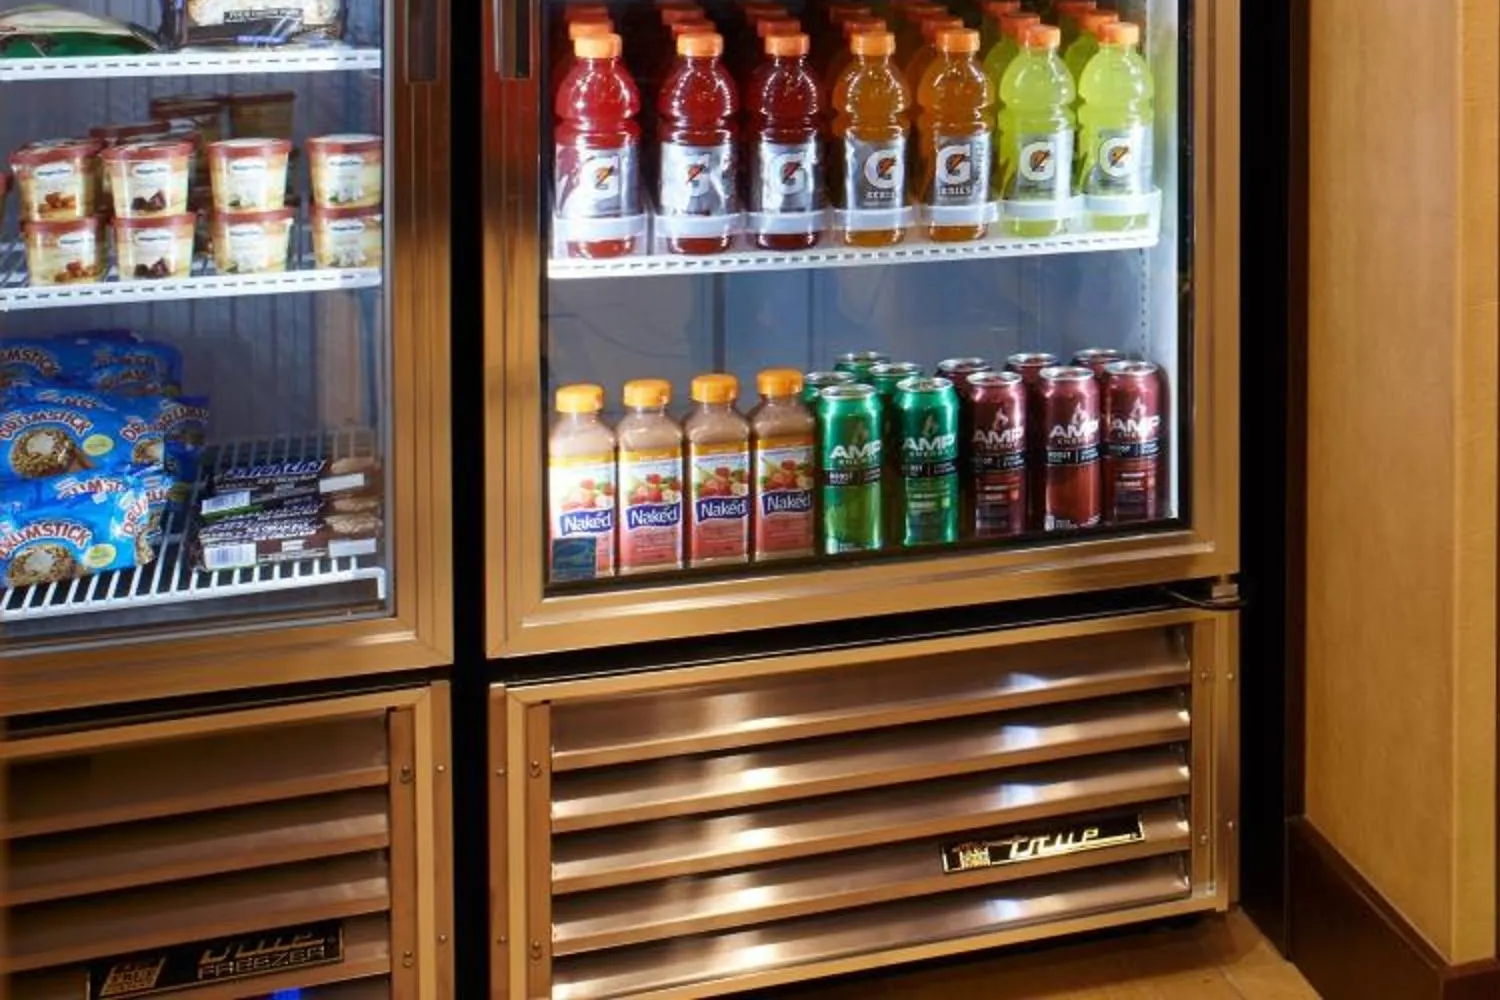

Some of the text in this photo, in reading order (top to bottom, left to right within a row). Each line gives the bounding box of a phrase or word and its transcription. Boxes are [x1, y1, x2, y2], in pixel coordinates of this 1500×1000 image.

[936, 144, 971, 186] G
[972, 425, 1025, 445] AMP
[1050, 418, 1100, 439] AMP
[1112, 414, 1161, 436] AMP
[830, 439, 882, 459] AMP
[902, 433, 957, 451] AMP
[700, 498, 747, 518] Naked
[766, 491, 812, 511] Naked
[563, 510, 612, 532] Naked
[630, 504, 680, 526] Naked
